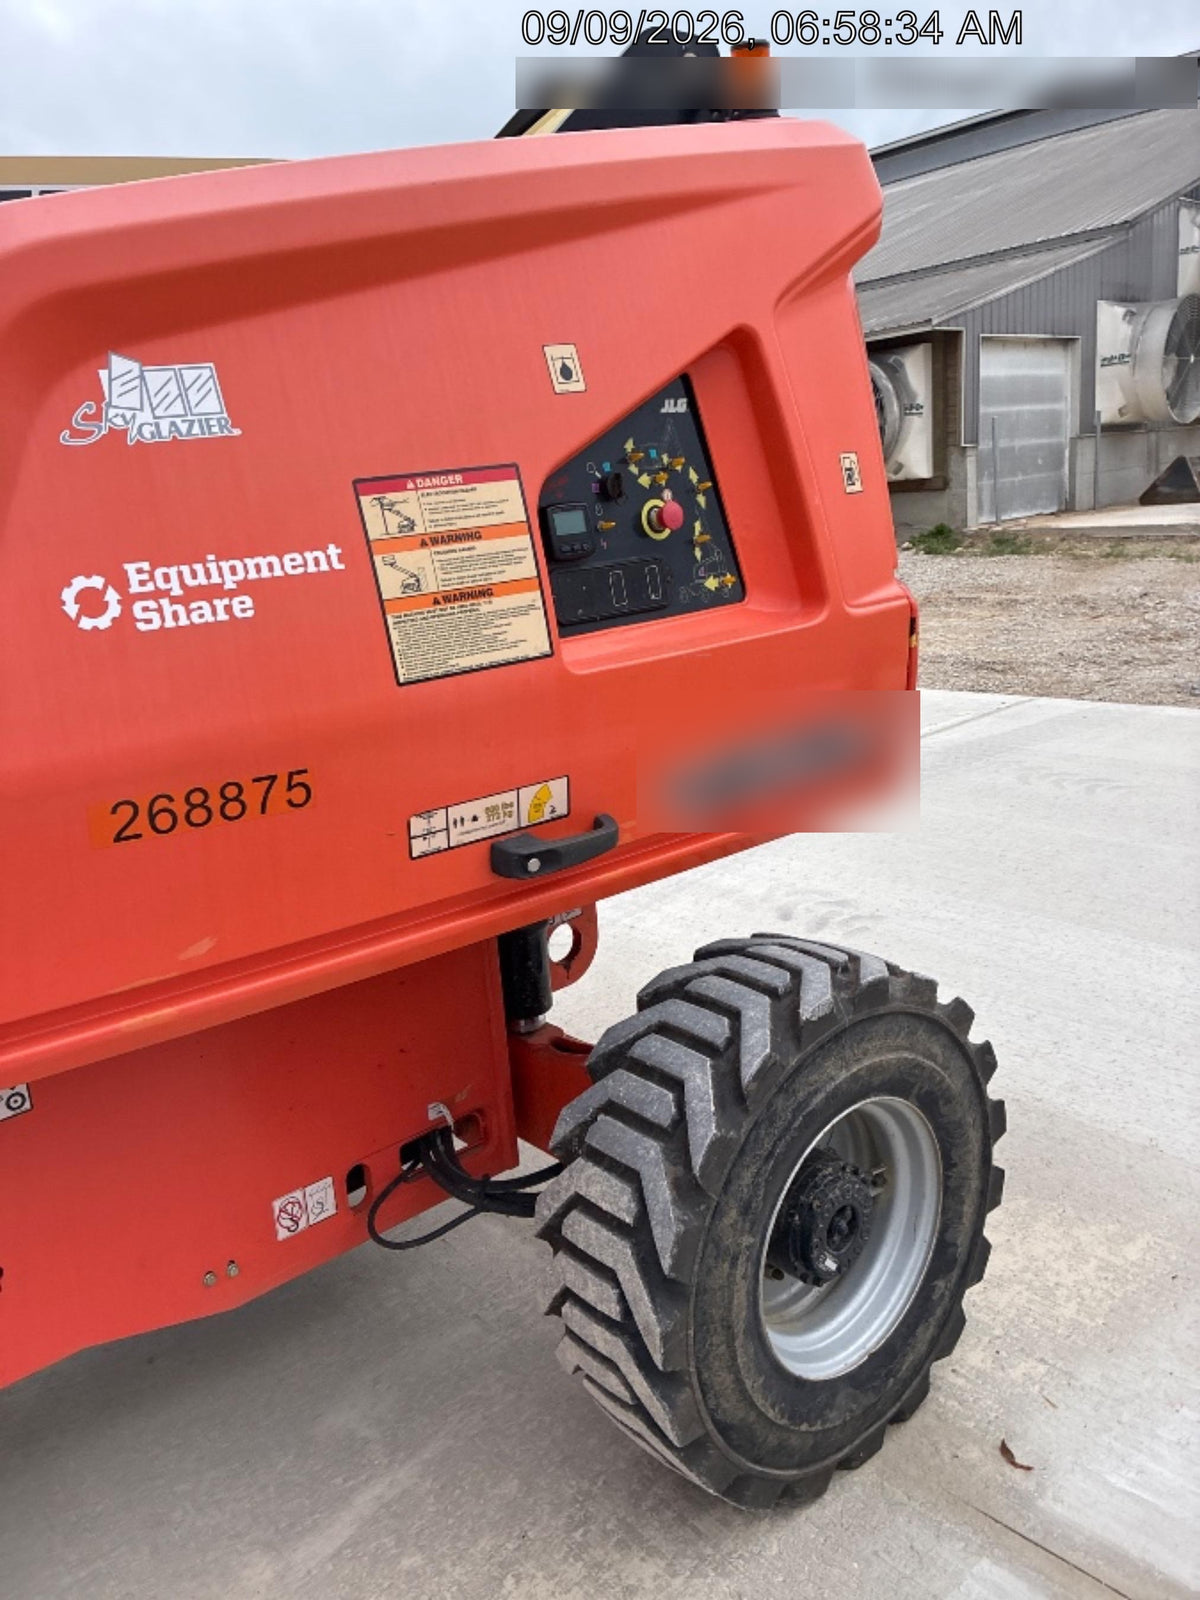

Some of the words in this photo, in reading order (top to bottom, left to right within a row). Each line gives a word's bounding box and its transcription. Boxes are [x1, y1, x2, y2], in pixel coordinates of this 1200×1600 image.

[660, 397, 689, 414] JLG
[416, 473, 463, 488] DANGER
[430, 530, 483, 547] WARNING
[123, 543, 345, 597] Equipment
[442, 587, 494, 604] WARNING
[132, 595, 255, 632] Share
[110, 768, 312, 843] 268875
